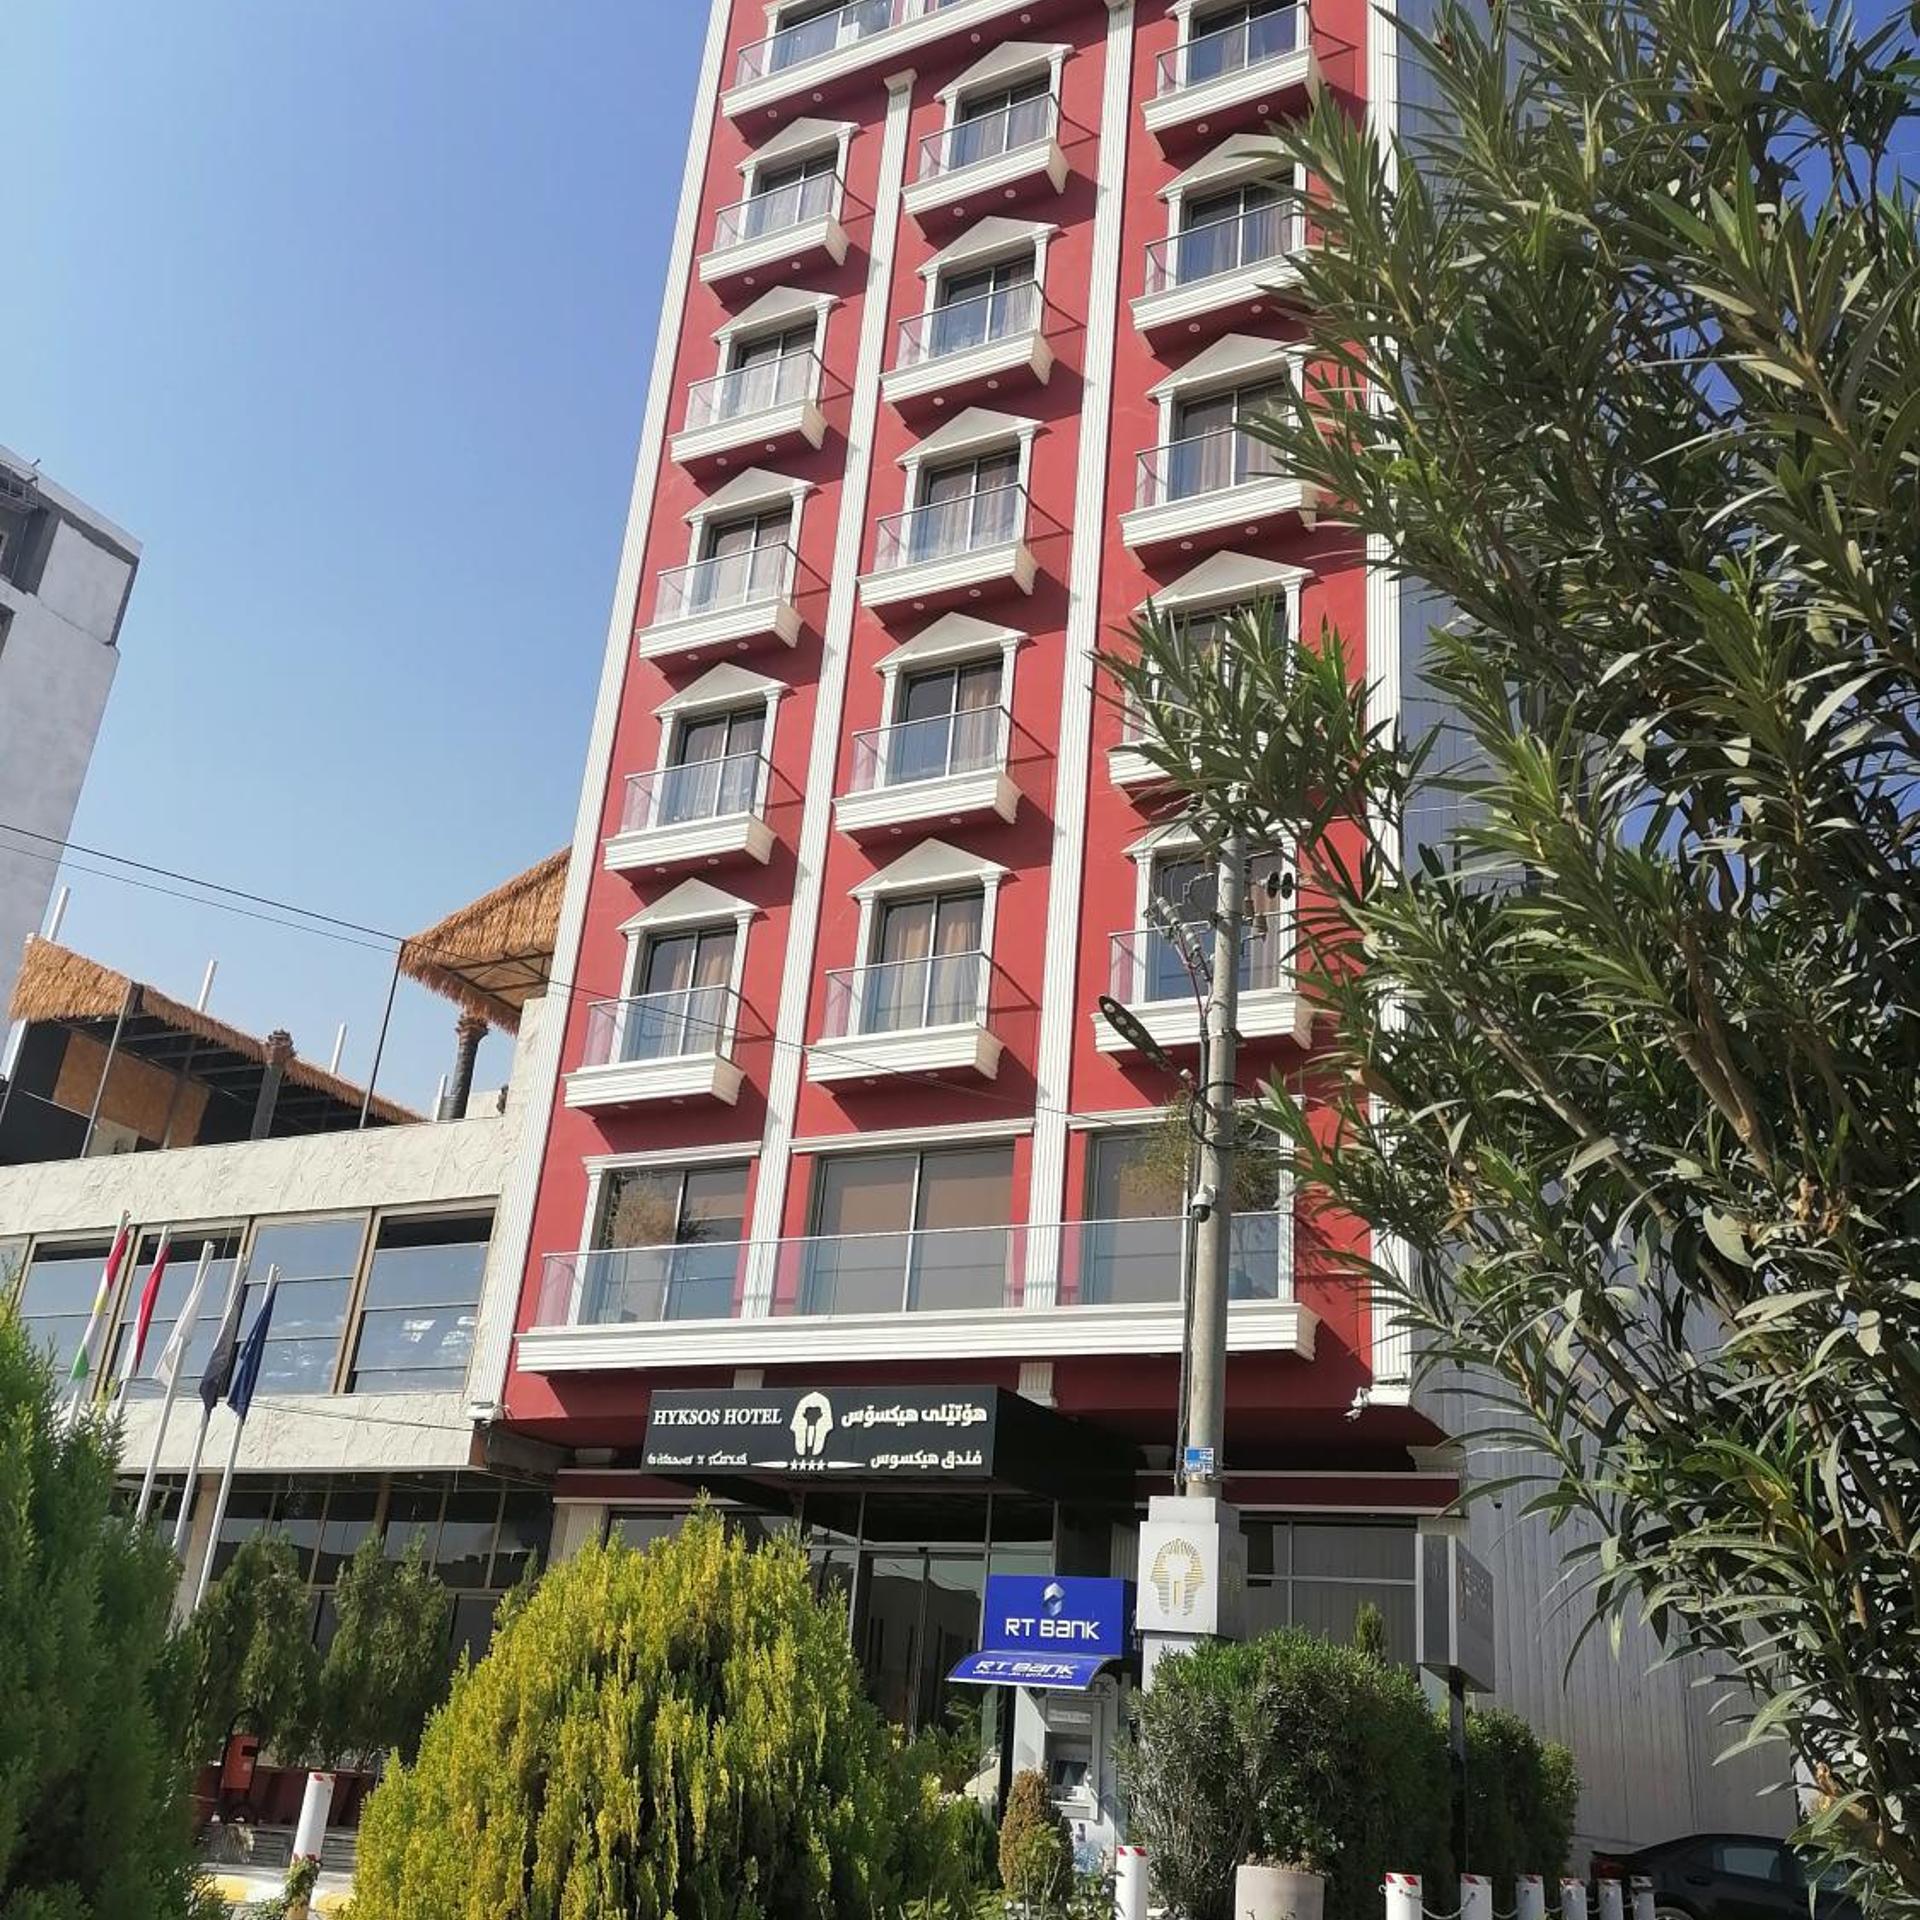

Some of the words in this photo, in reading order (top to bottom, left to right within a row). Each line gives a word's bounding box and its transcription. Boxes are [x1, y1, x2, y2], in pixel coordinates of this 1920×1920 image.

[653, 1409, 721, 1425] HYKSOS
[723, 1408, 783, 1425] HOTEL
[941, 1450, 982, 1470] فندق
[1005, 1618, 1036, 1637] RT
[975, 1660, 1012, 1672] RT
